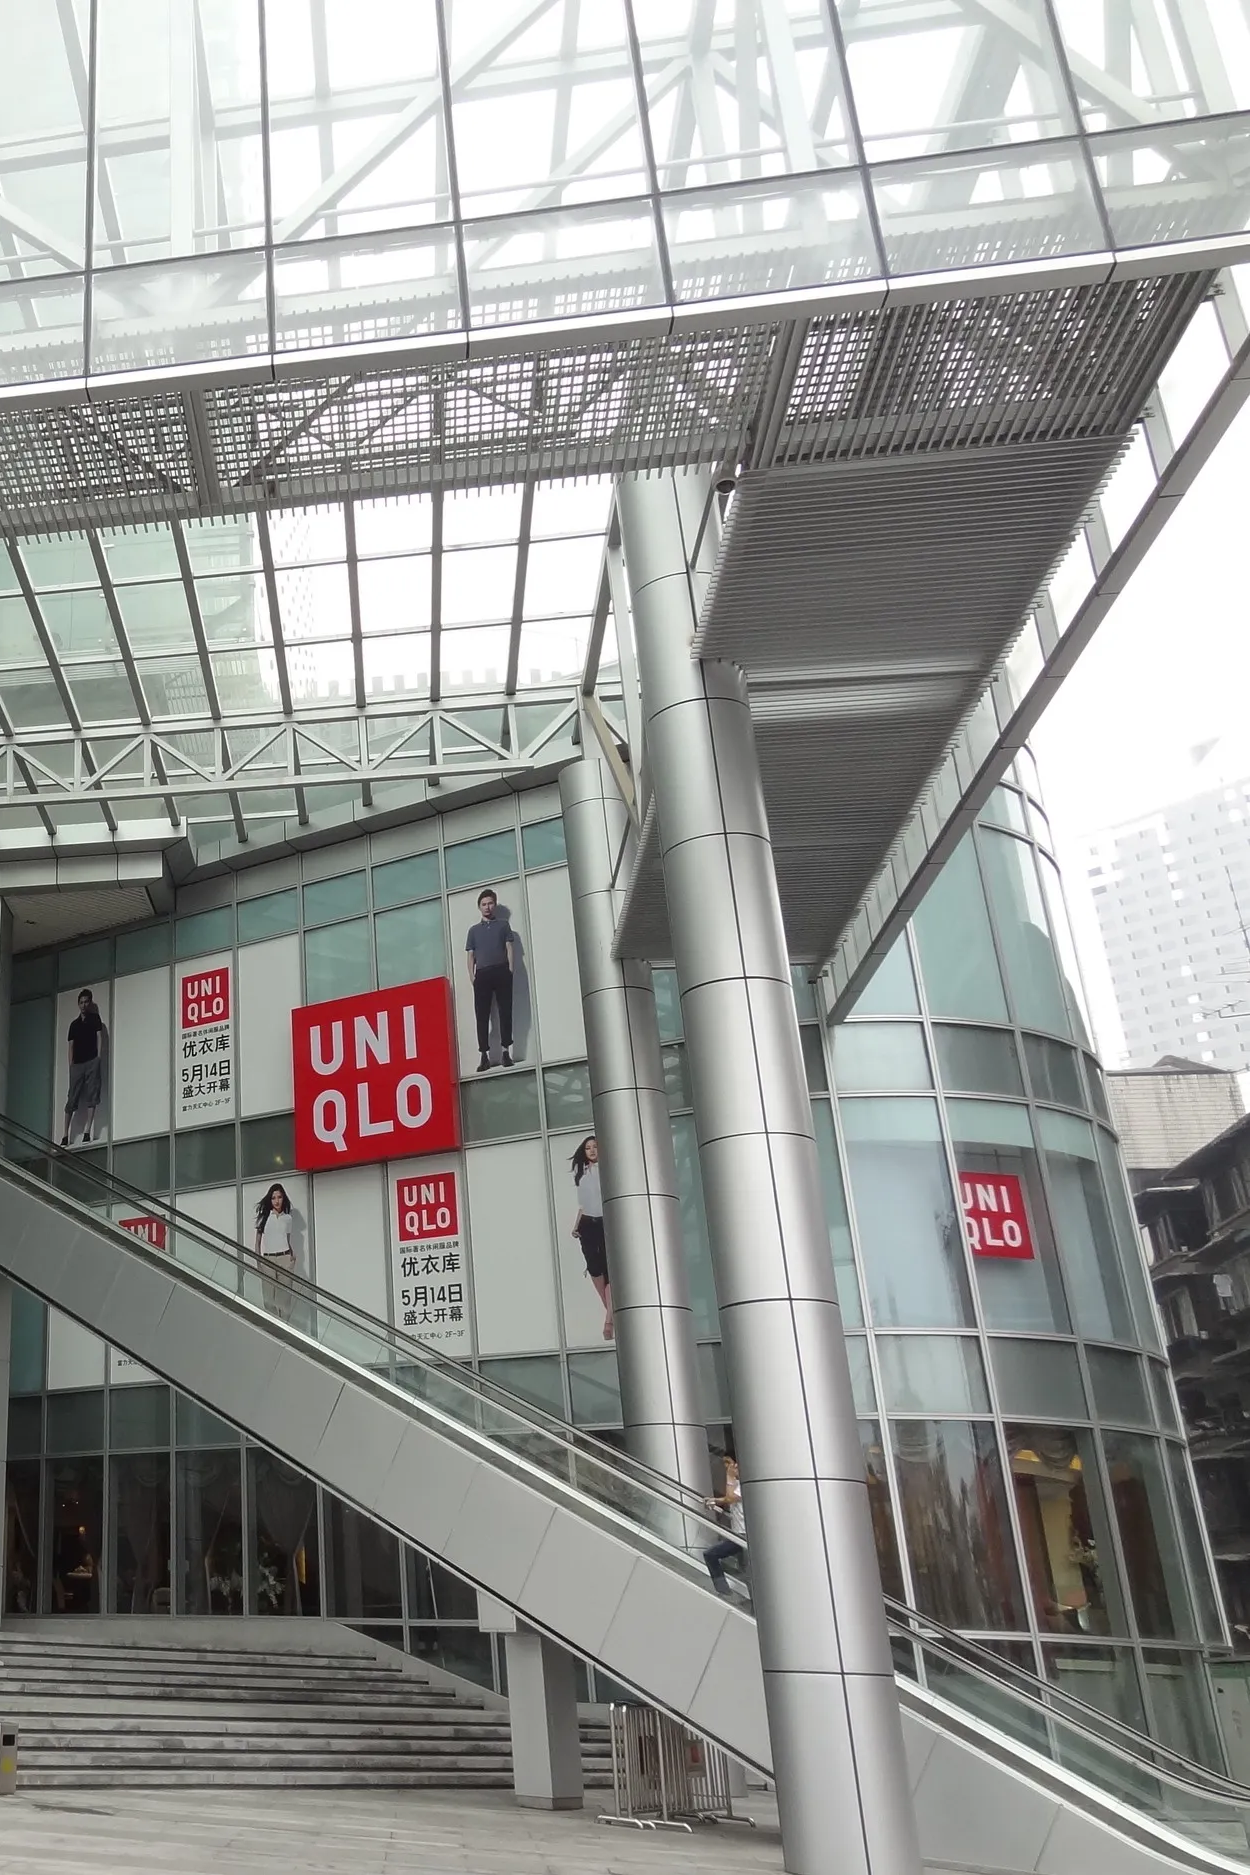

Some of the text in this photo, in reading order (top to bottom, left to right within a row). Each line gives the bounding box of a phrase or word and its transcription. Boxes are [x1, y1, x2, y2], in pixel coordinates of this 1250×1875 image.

[187, 976, 220, 999] UNI
[187, 997, 224, 1023] QLO
[182, 1034, 230, 1058] 优衣库
[310, 1005, 417, 1075] UNI
[182, 1059, 231, 1083] 5月14日
[182, 1078, 231, 1099] 盛大开幕
[313, 1073, 433, 1152] QLO
[403, 1181, 445, 1207] UNI
[405, 1207, 451, 1236] QLO
[401, 1252, 461, 1278] 优衣库
[401, 1283, 463, 1307] 5月14日
[403, 1306, 464, 1326] 盛大开幕
[445, 1329, 465, 1339] 2F-3F
